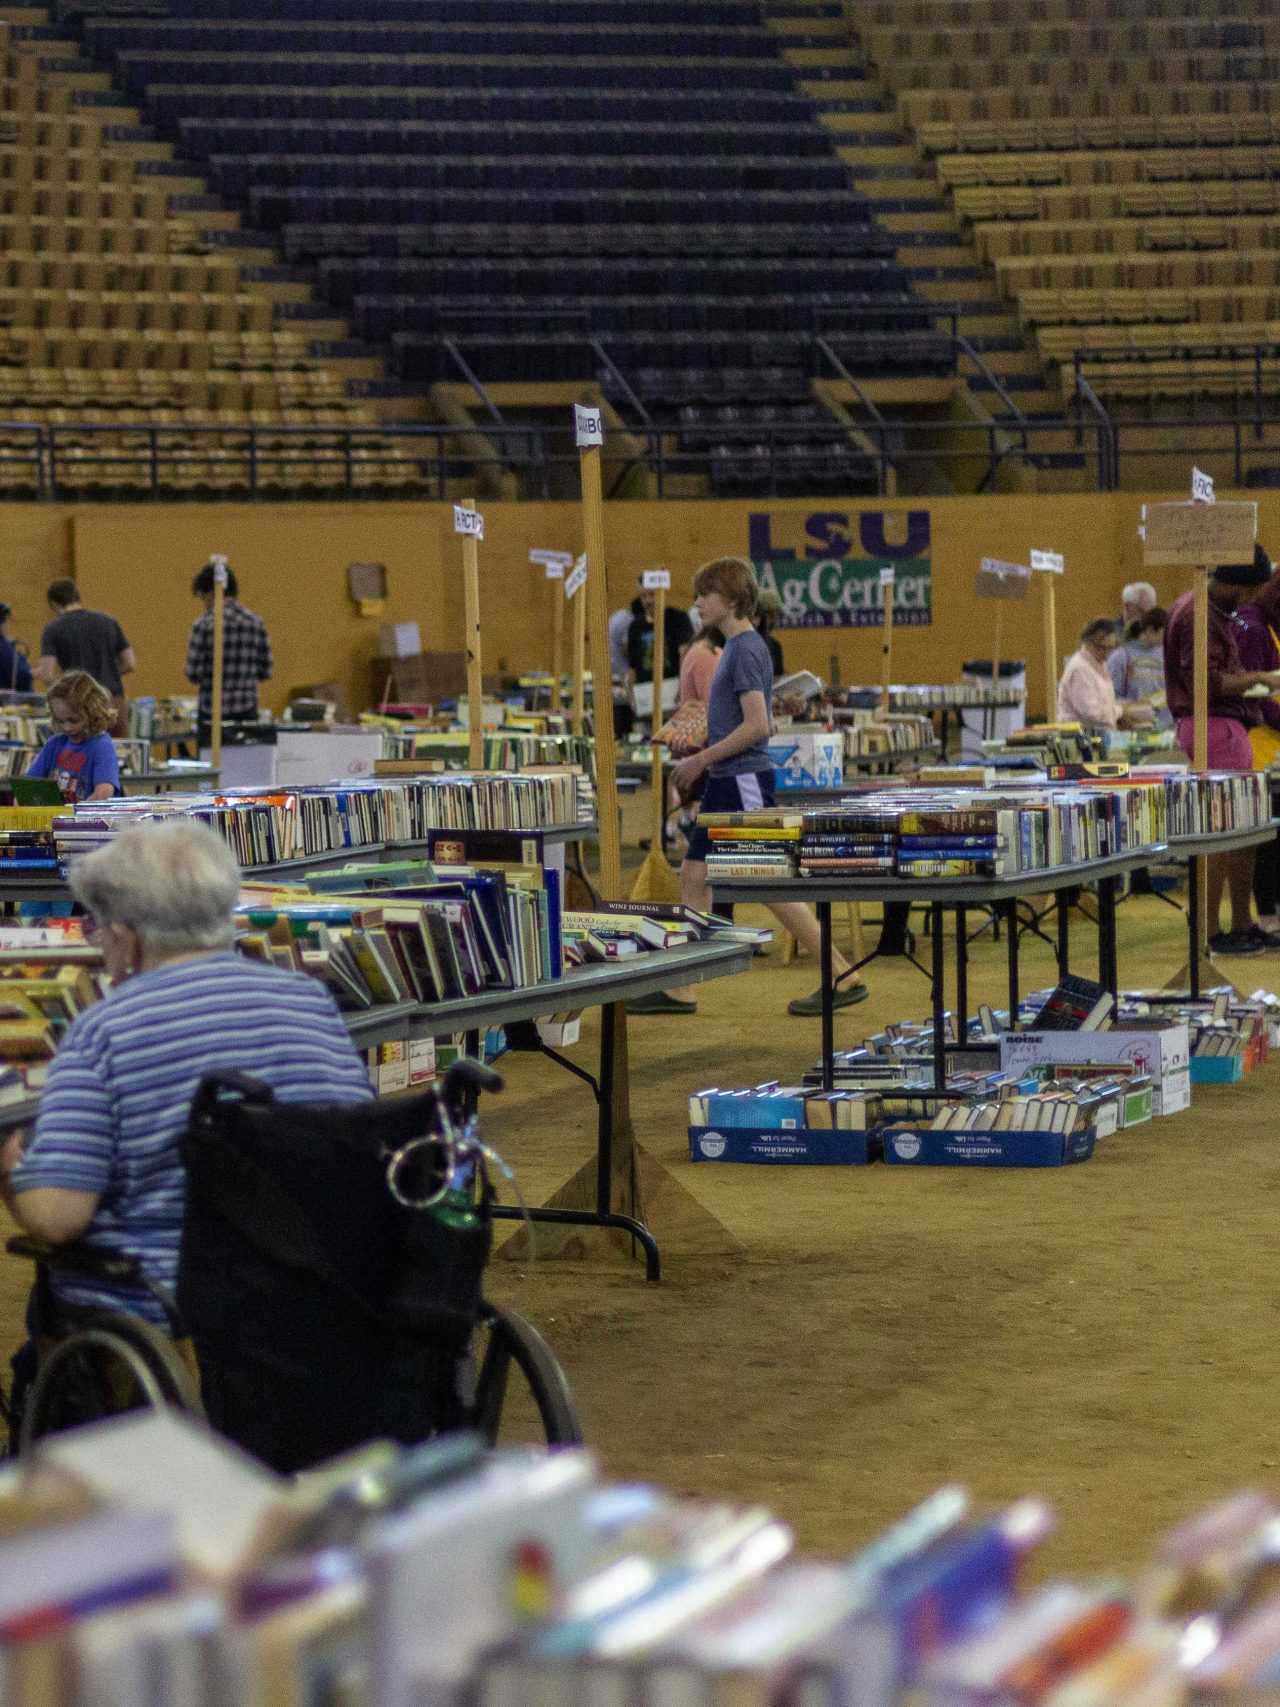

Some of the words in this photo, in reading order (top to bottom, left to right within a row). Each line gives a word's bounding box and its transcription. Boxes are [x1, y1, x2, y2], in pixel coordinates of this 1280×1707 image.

[748, 511, 931, 560] LSU
[756, 559, 931, 618] AgCener
[628, 904, 659, 912] JOURNAL
[751, 1145, 807, 1154] HAMMERMILL
[944, 1145, 1002, 1154] HAMMERMILL
